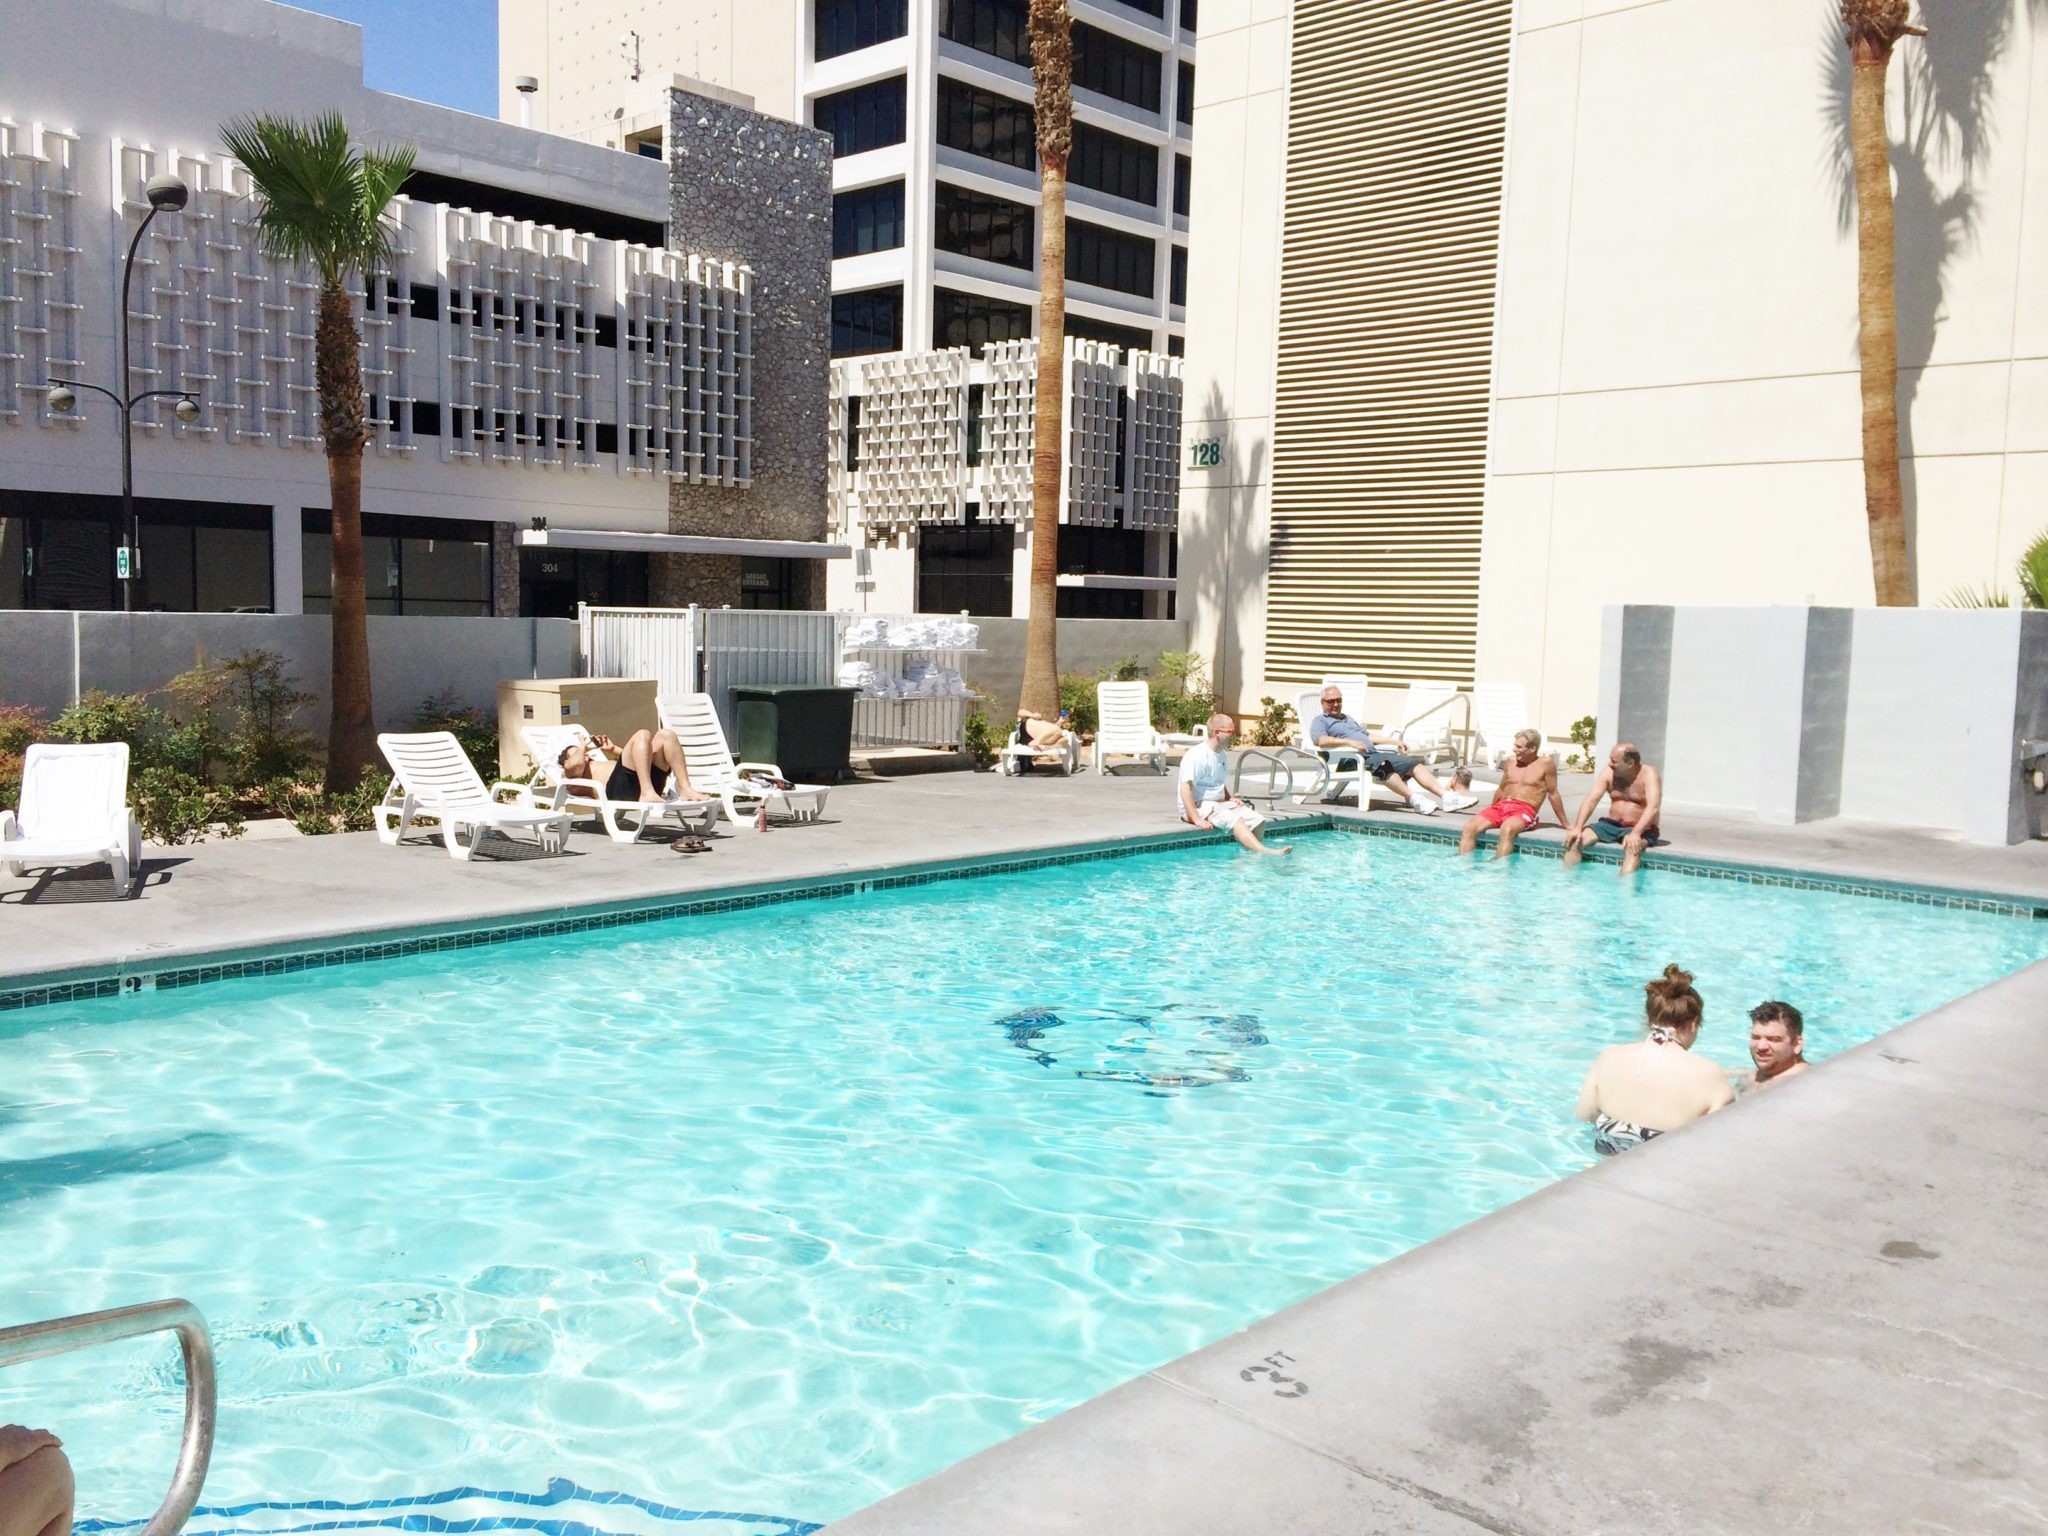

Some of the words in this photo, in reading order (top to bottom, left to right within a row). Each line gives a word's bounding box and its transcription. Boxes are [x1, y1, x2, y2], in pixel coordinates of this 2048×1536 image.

[1191, 443, 1220, 466] 128
[542, 563, 558, 573] 304
[1240, 1366, 1308, 1398] 3
